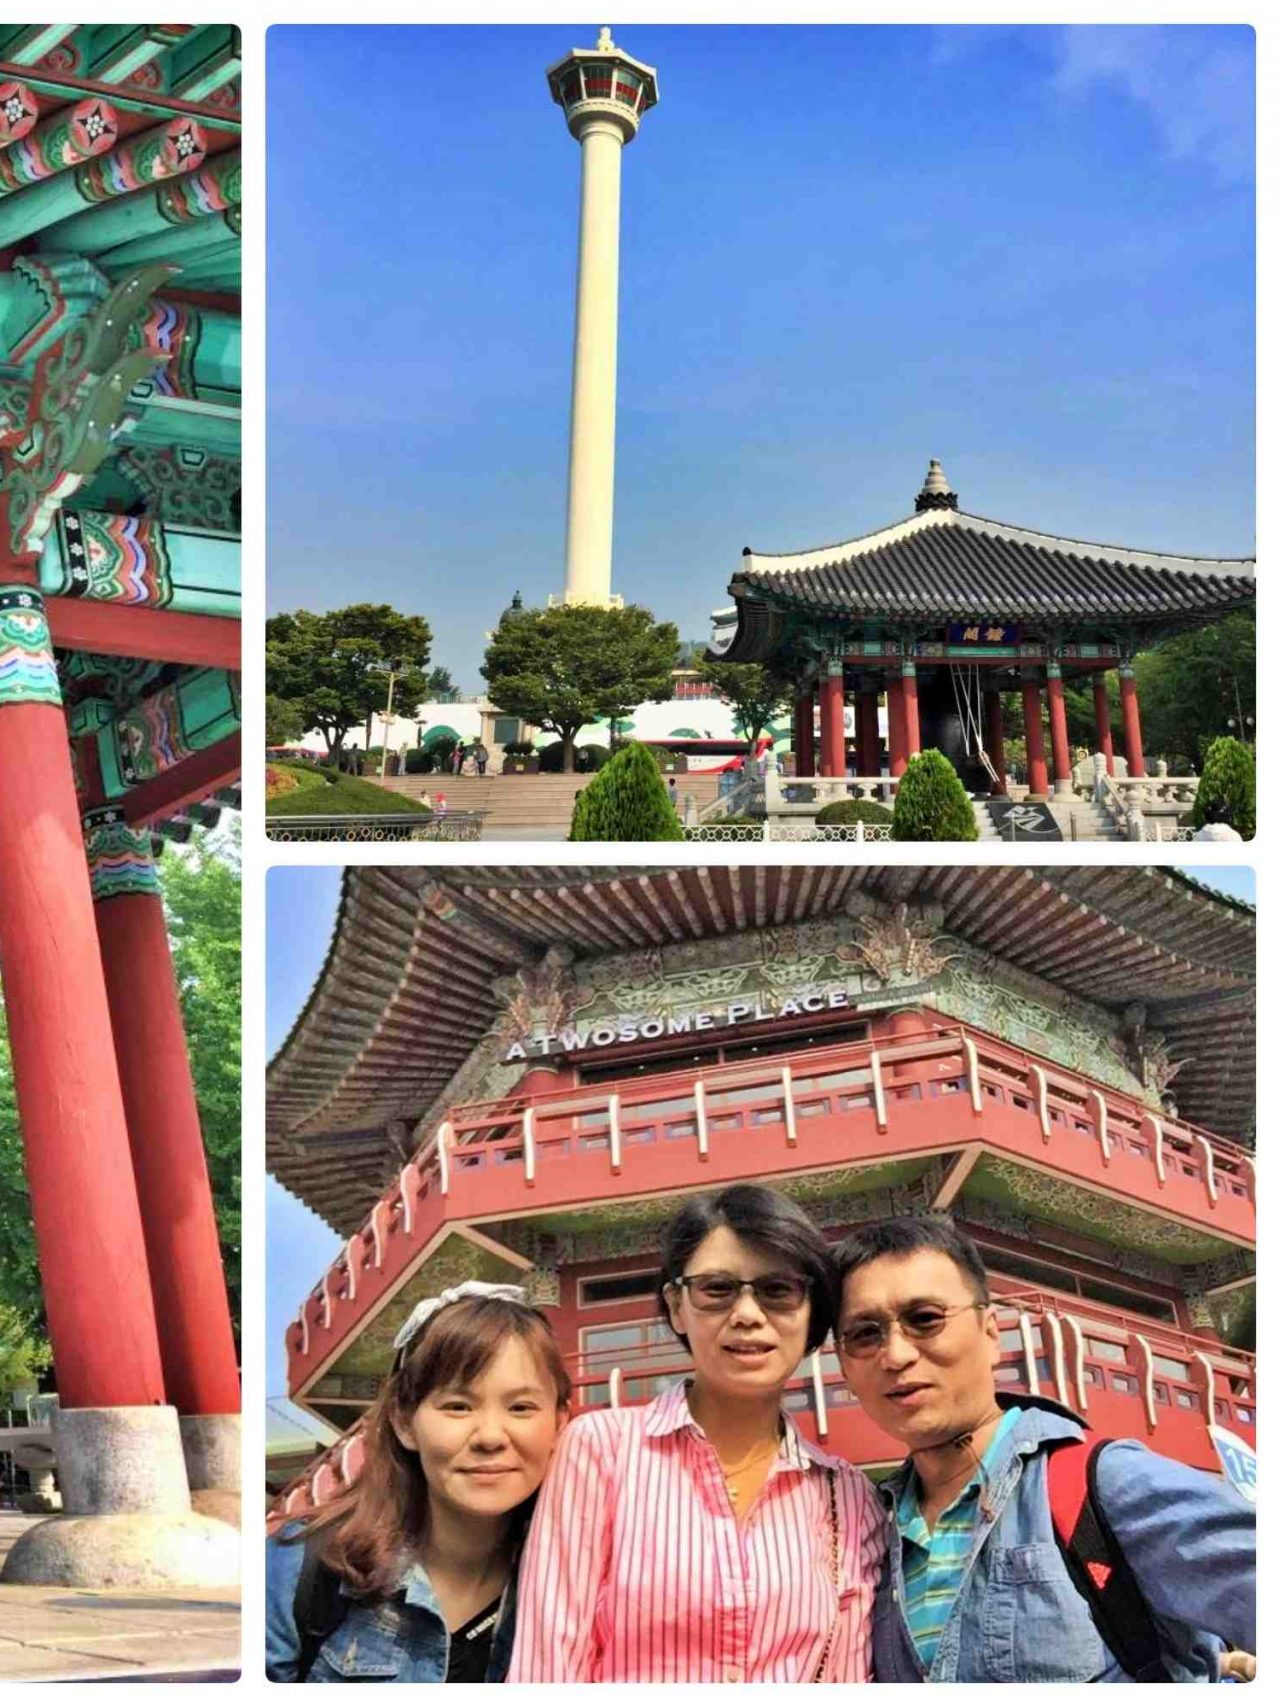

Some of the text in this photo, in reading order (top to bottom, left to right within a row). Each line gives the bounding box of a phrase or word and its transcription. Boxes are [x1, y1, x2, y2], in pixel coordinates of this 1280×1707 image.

[506, 1042, 527, 1060] A
[535, 1012, 715, 1055] TWOSOME
[727, 990, 849, 1025] PLACE
